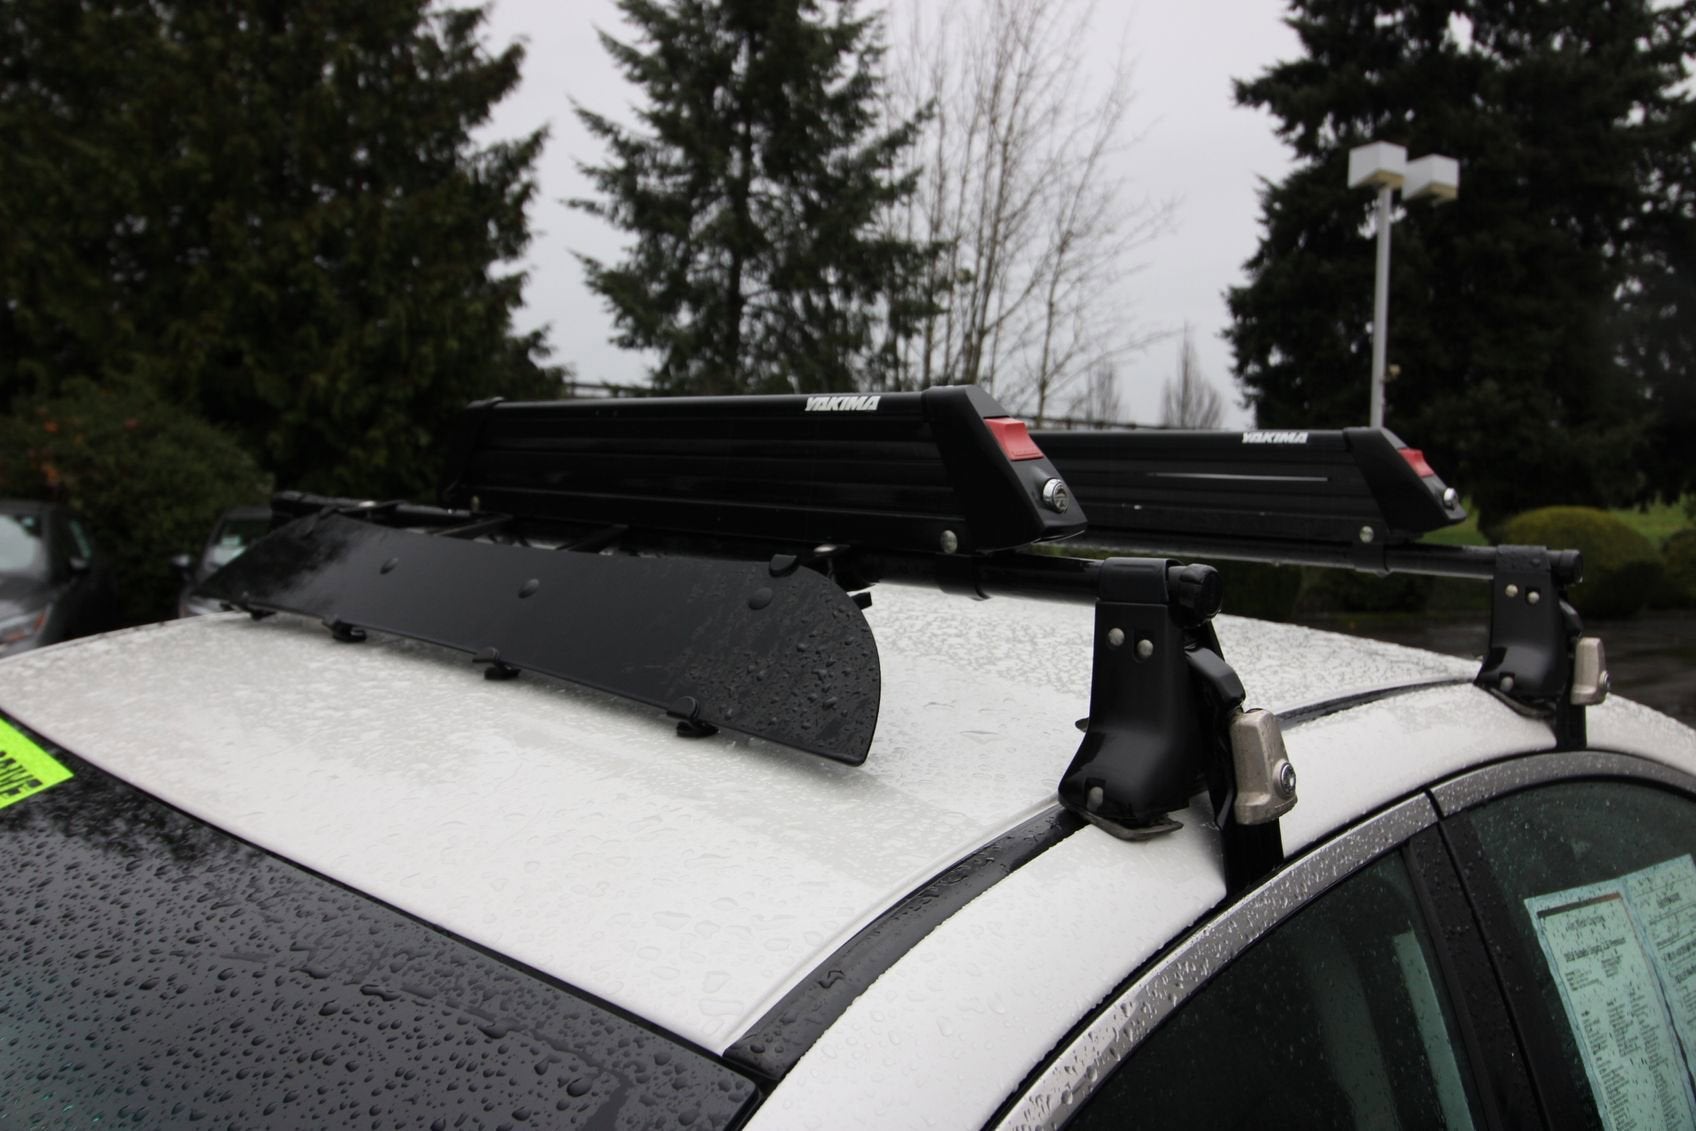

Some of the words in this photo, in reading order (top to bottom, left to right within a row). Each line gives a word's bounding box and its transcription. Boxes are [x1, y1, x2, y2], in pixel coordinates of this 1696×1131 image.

[804, 395, 881, 412] YAKIMA
[1241, 430, 1309, 444] YAKIMA
[0, 750, 43, 798] IVE
